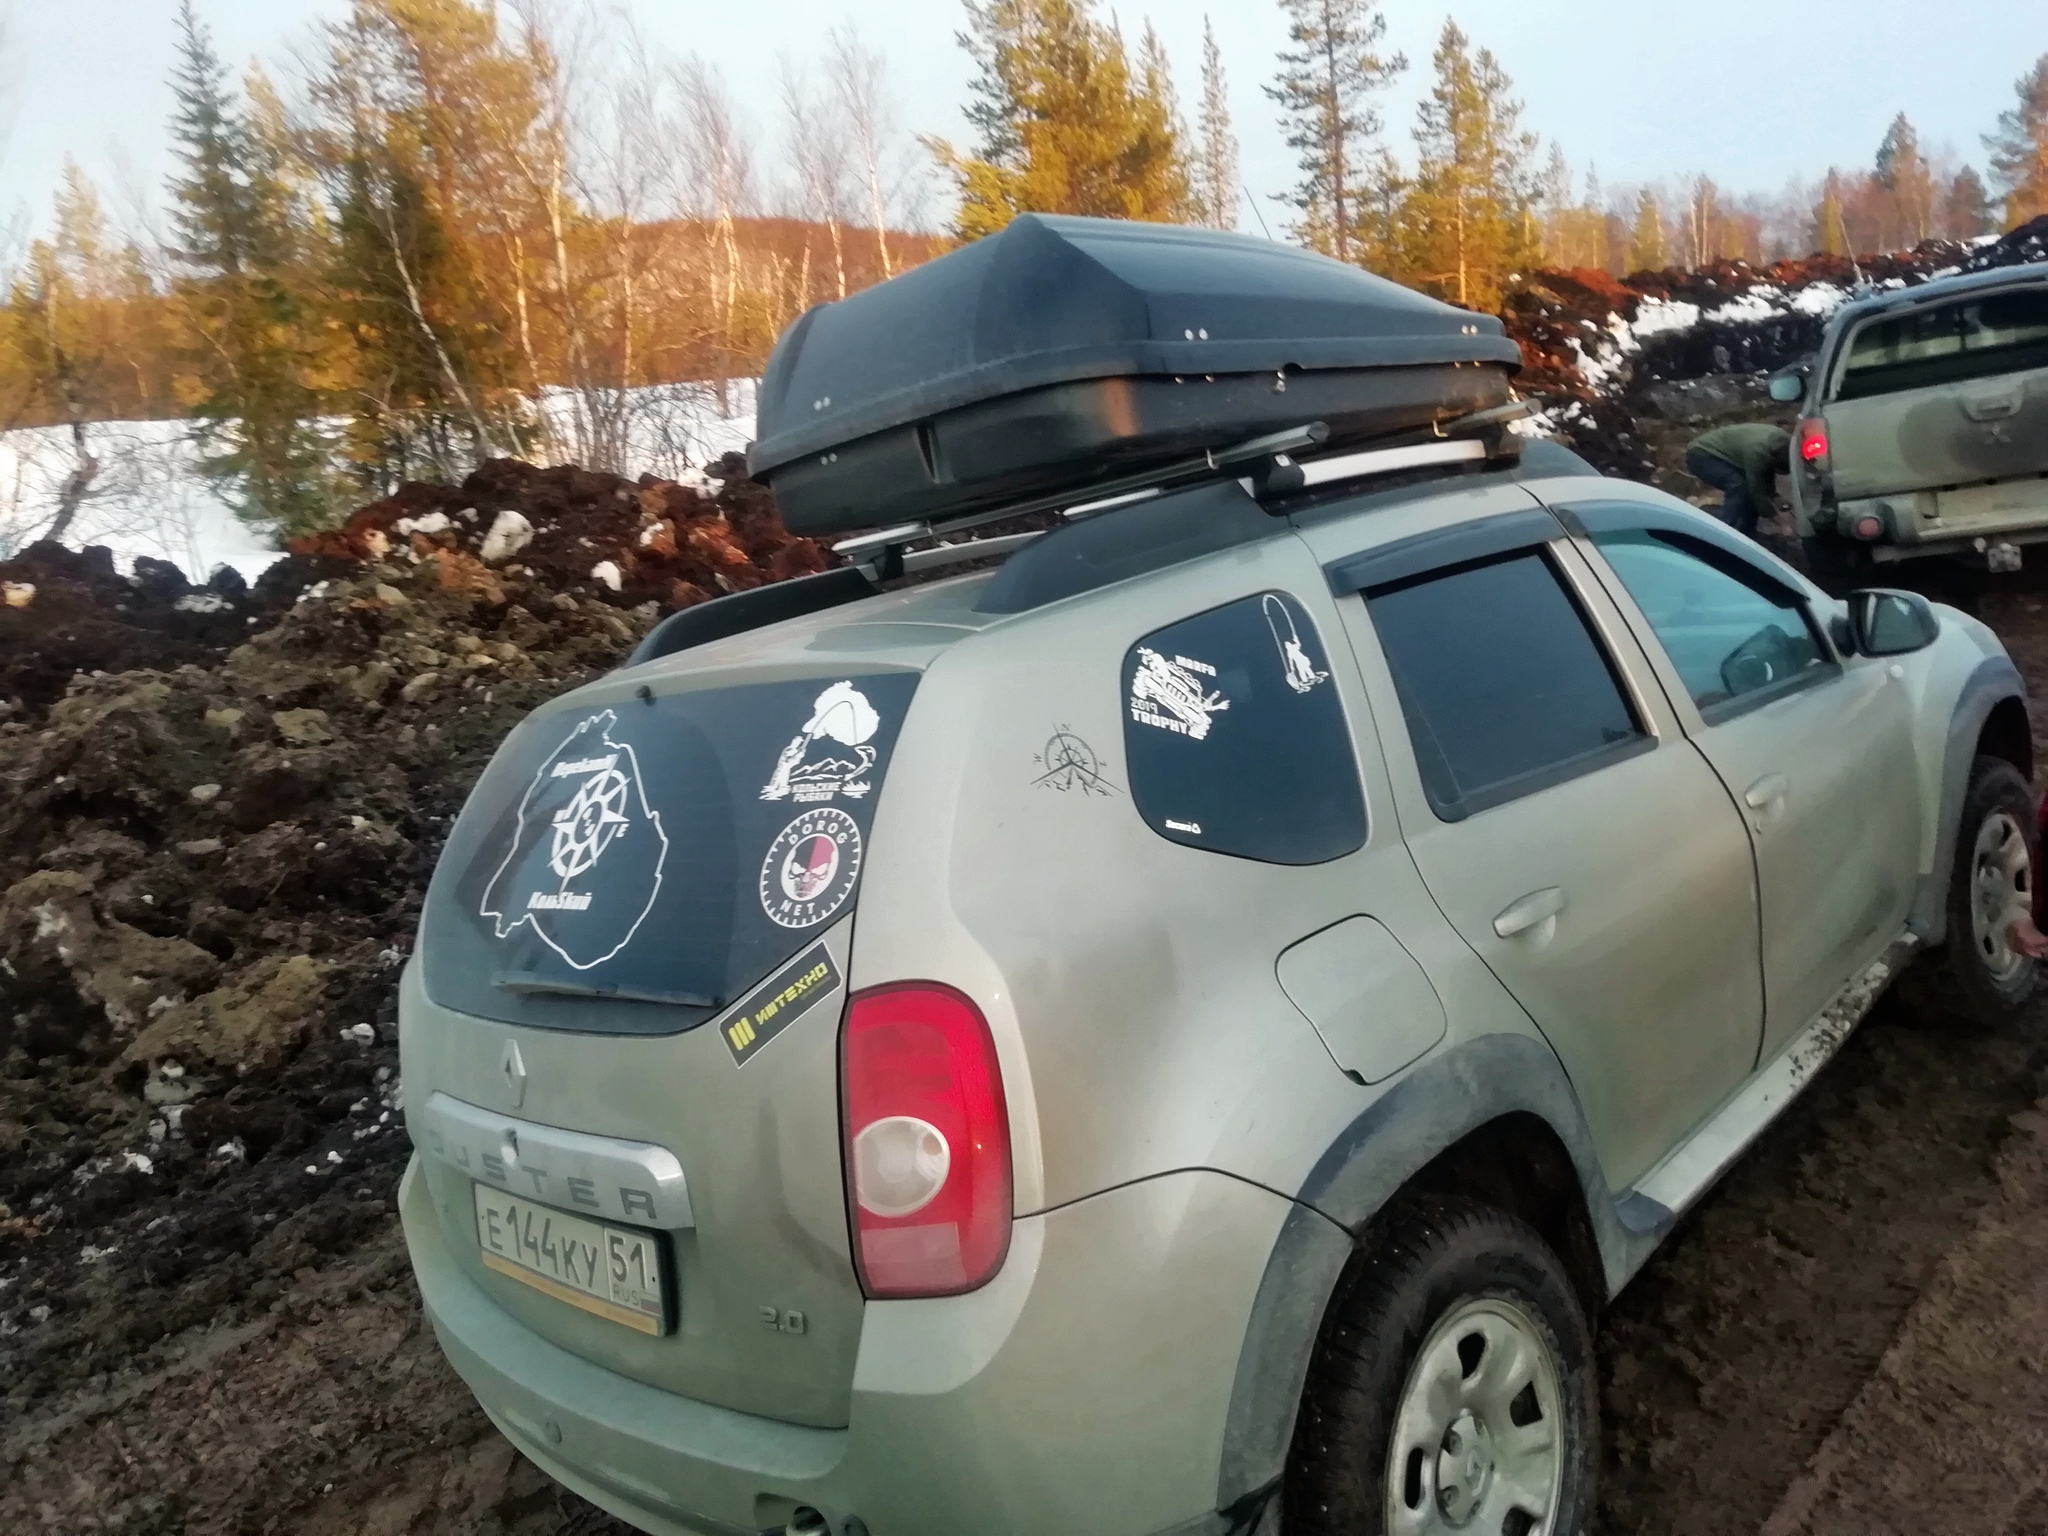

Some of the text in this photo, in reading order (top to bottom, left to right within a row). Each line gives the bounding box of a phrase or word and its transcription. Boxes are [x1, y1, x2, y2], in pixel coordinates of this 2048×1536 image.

[1131, 697, 1159, 715] 2019
[1131, 708, 1188, 735] TROPHY
[780, 899, 816, 917] NET
[608, 1234, 648, 1290] 51
[613, 1282, 640, 1307] RUS
[759, 1305, 809, 1335] 2.0
